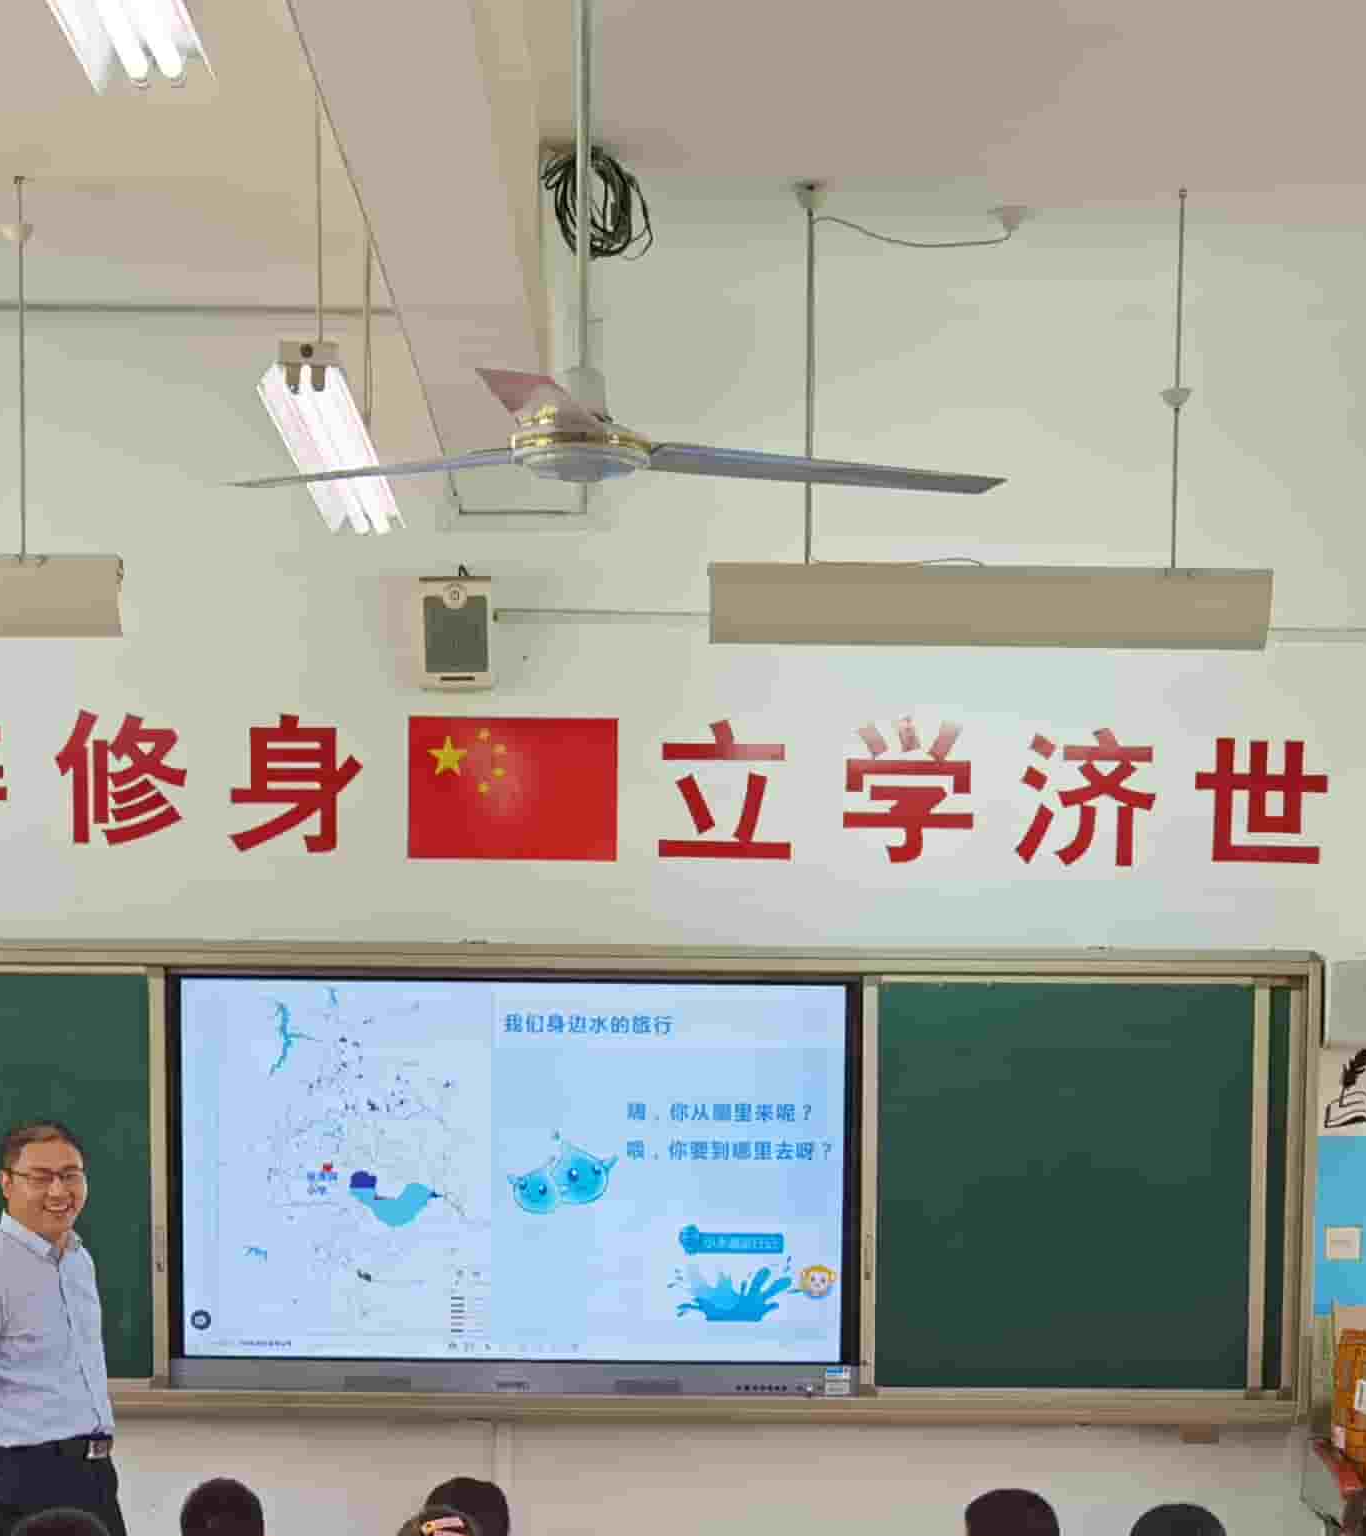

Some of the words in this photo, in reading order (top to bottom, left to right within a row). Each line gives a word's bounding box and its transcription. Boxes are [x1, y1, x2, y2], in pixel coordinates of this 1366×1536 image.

[658, 716, 1330, 867] 立学济世
[503, 1013, 675, 1035] 我们身边水的旅行
